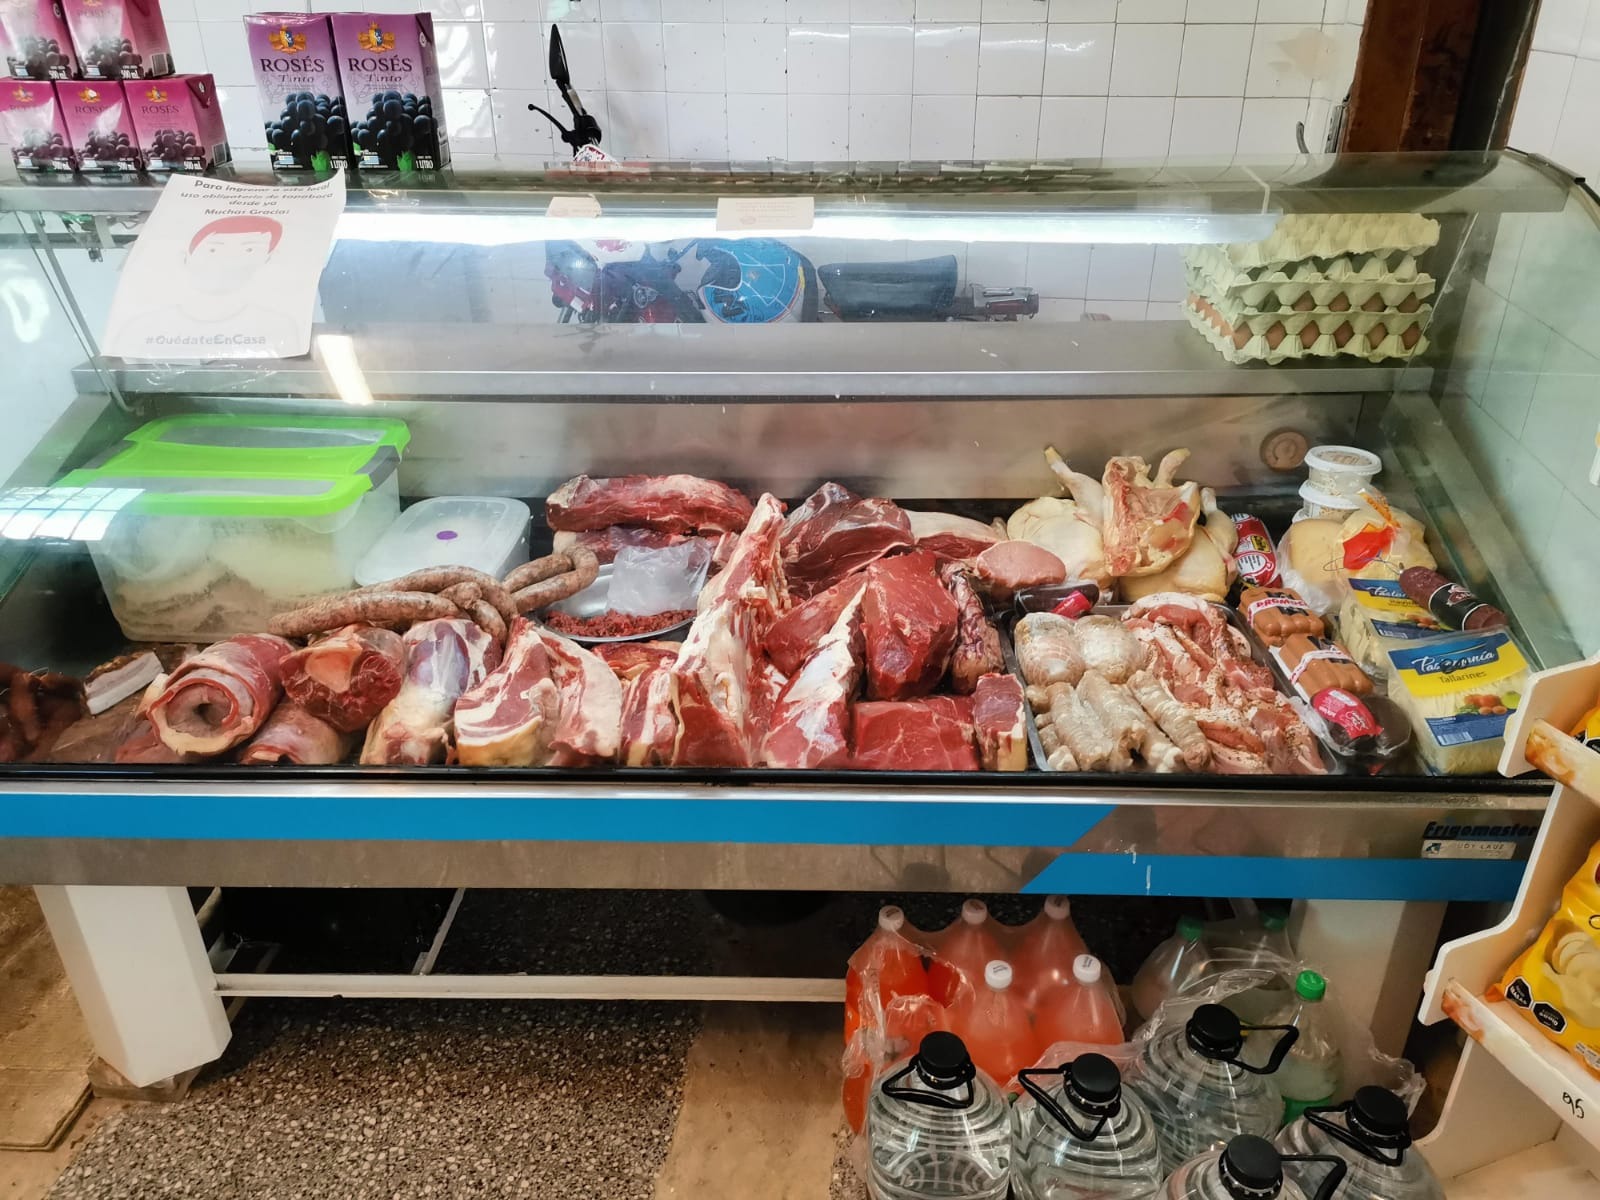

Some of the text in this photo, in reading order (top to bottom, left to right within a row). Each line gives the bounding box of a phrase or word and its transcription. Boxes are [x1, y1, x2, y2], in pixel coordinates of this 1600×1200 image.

[260, 55, 325, 73] ROSÉS
[347, 54, 413, 72] ROSÉS
[277, 74, 314, 83] Tinto
[367, 74, 402, 83] Tinto
[194, 179, 223, 191] Para
[1439, 670, 1488, 684] Tallarines
[1562, 1091, 1585, 1119] 95
